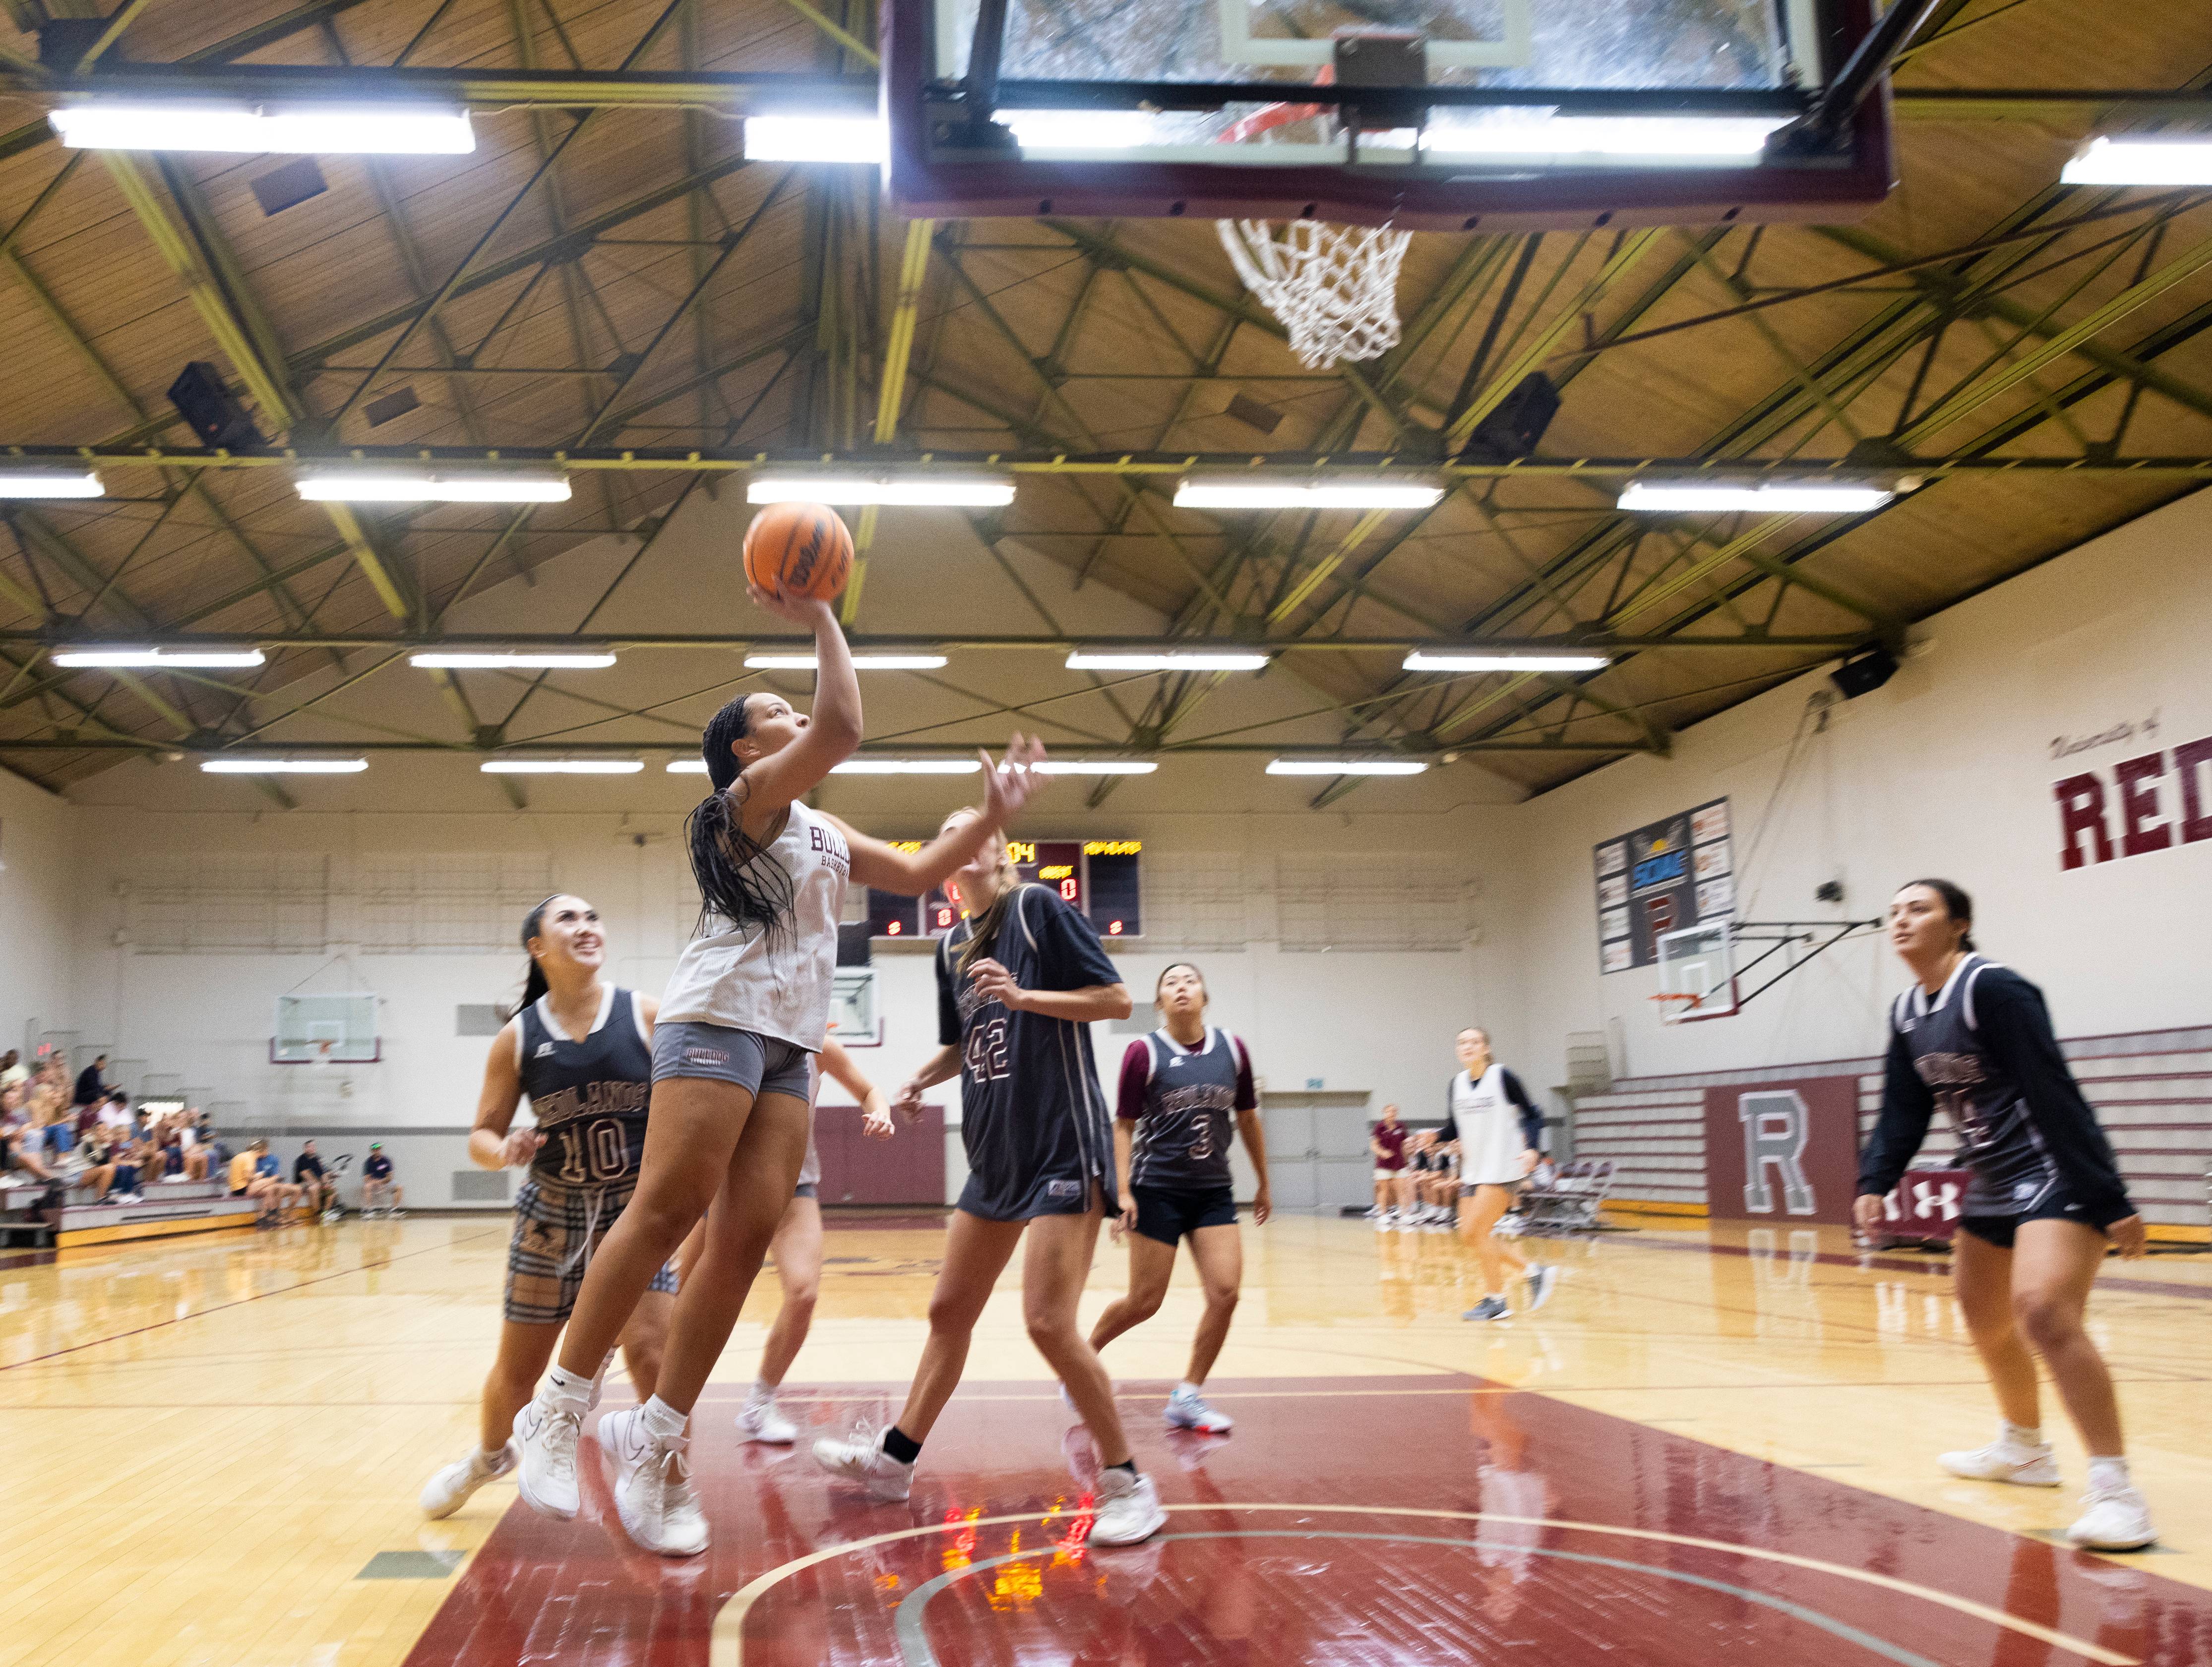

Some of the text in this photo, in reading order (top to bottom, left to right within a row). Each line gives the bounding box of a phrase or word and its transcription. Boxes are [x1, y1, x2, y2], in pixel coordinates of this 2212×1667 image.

[2051, 736, 2212, 872] RED
[1060, 878, 1077, 900] 0
[966, 1017, 1010, 1084] 42
[558, 1117, 630, 1183] 10
[1189, 1114, 1214, 1160] 3
[1738, 1089, 1817, 1216] R
